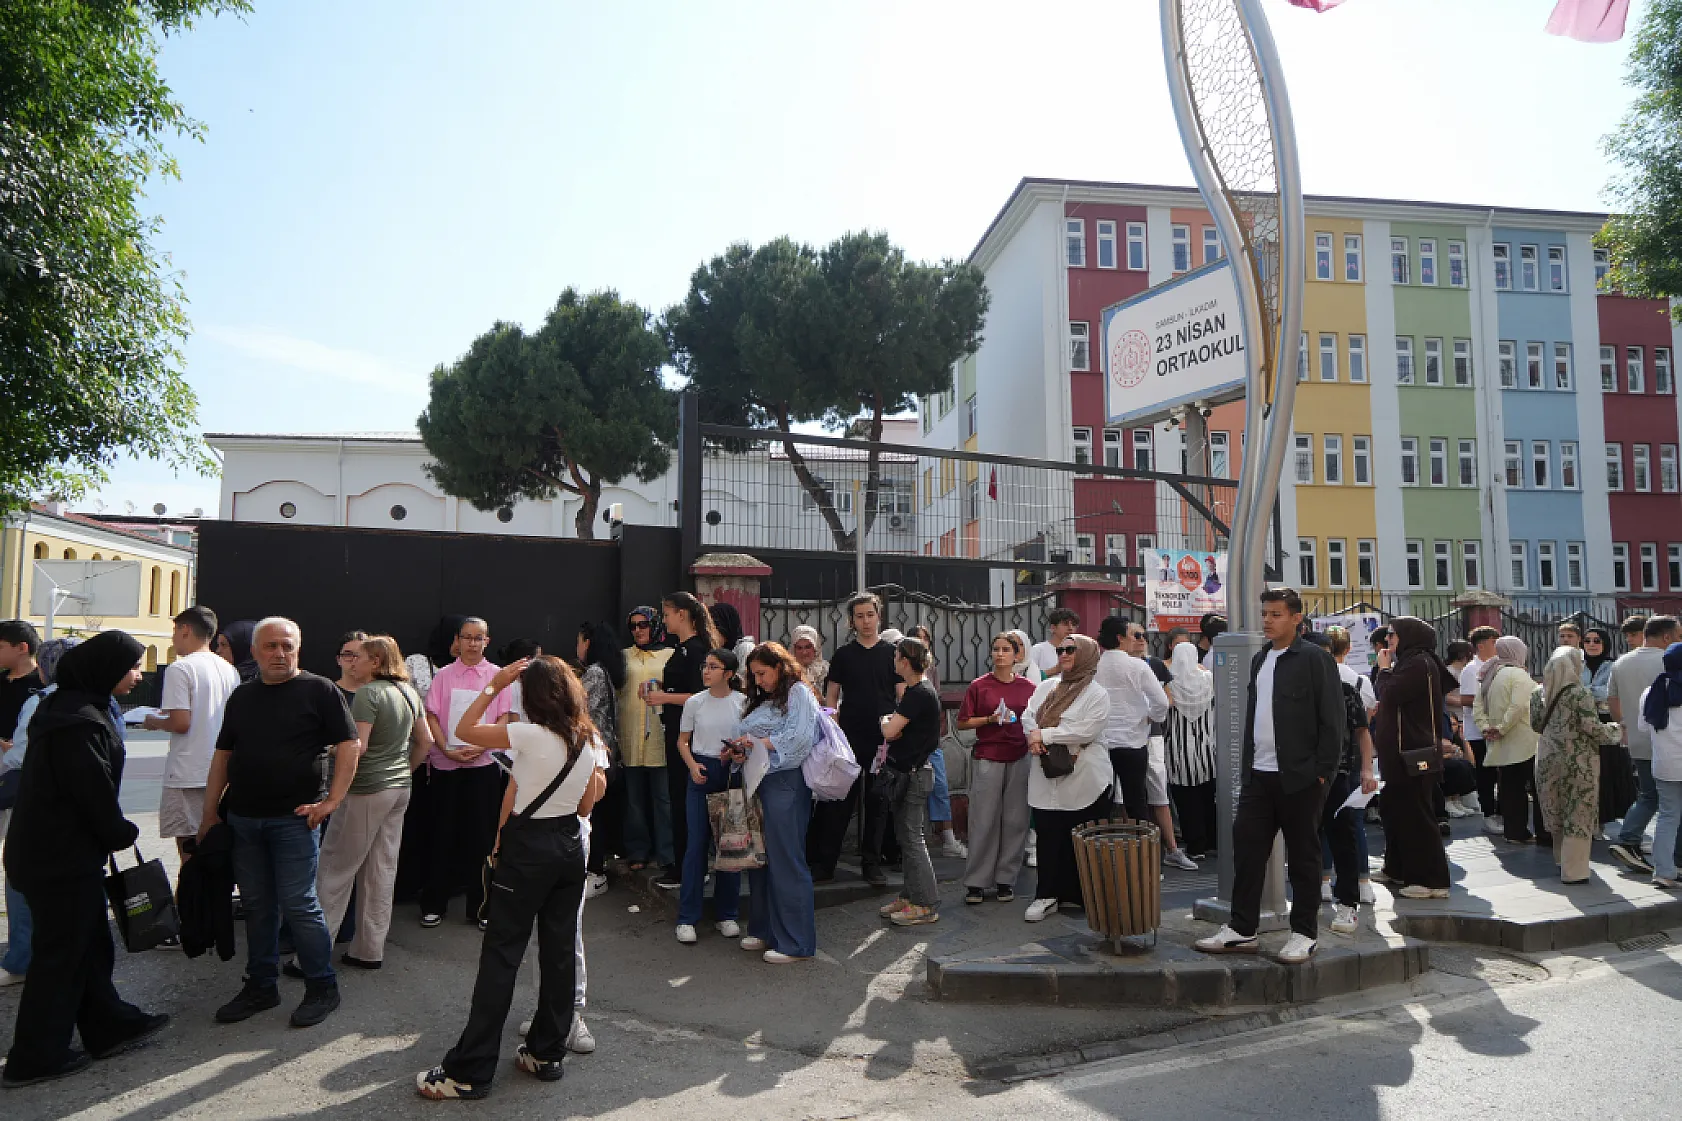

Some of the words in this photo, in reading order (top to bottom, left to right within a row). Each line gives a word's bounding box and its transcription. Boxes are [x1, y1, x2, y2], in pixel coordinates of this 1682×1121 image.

[1156, 312, 1184, 330] SAMSUN
[1156, 332, 1172, 354] 23
[1176, 311, 1226, 346] NİSAN
[1156, 333, 1245, 377] ORTAOKUL
